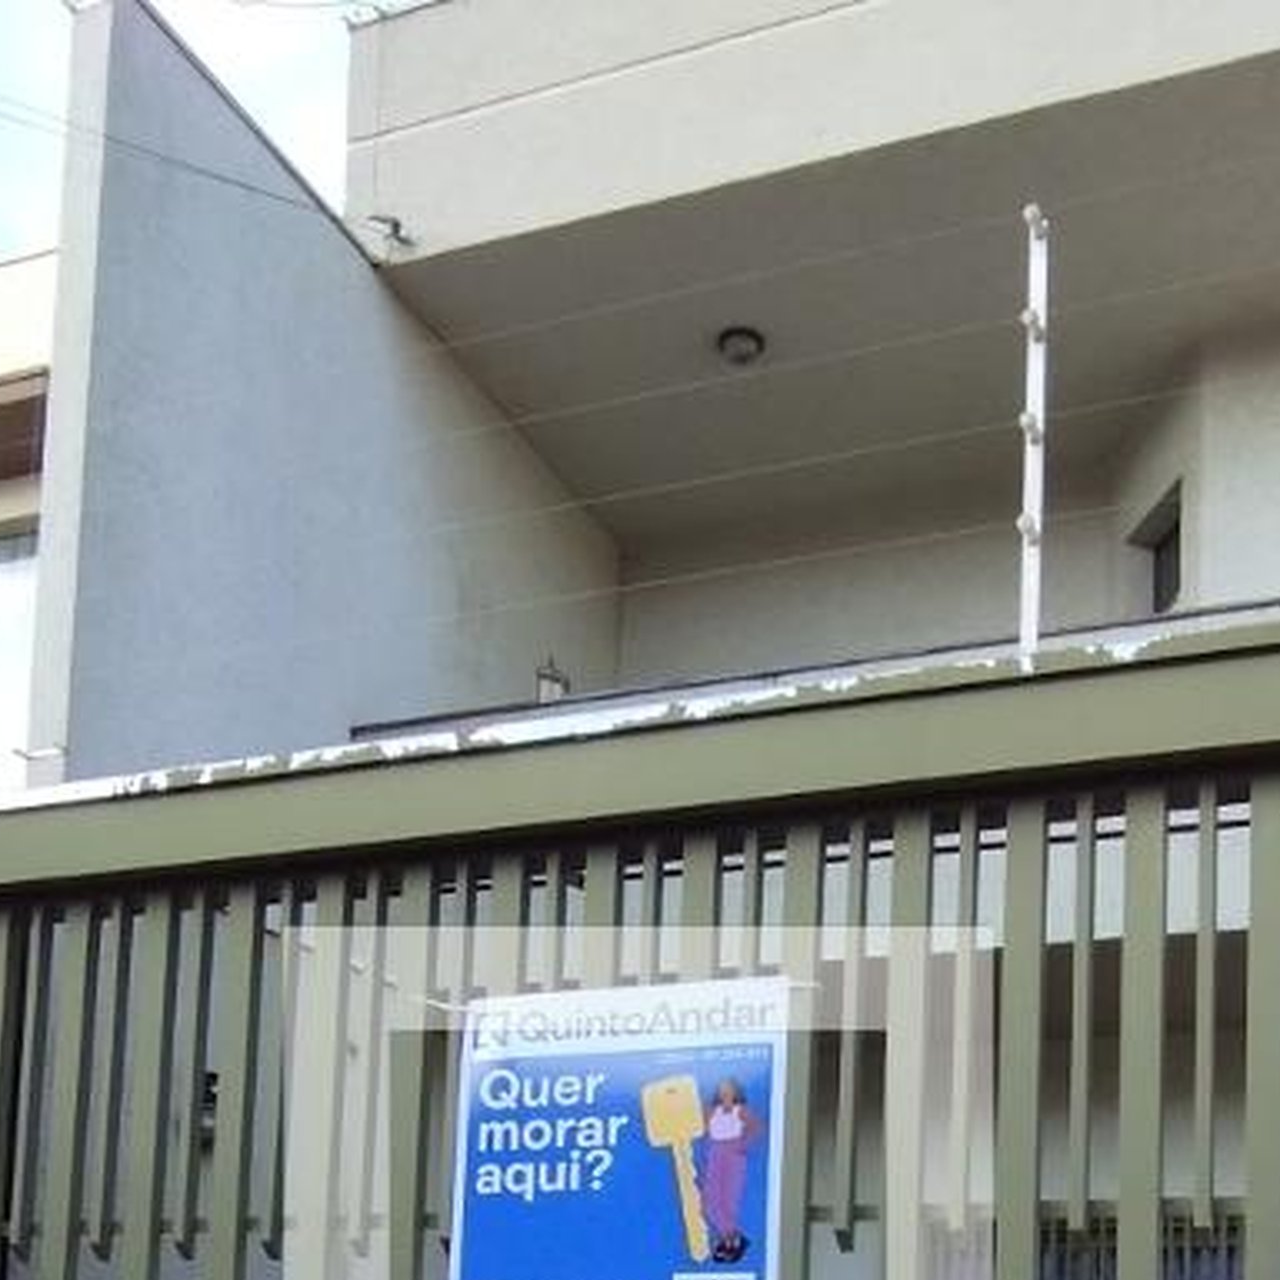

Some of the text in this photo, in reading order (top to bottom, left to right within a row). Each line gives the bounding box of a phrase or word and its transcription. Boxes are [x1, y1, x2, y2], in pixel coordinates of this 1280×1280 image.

[521, 997, 776, 1042] QuintoAndar
[480, 1069, 605, 1110] Quer
[479, 1115, 629, 1152] morar
[476, 1149, 613, 1202] aqui?
